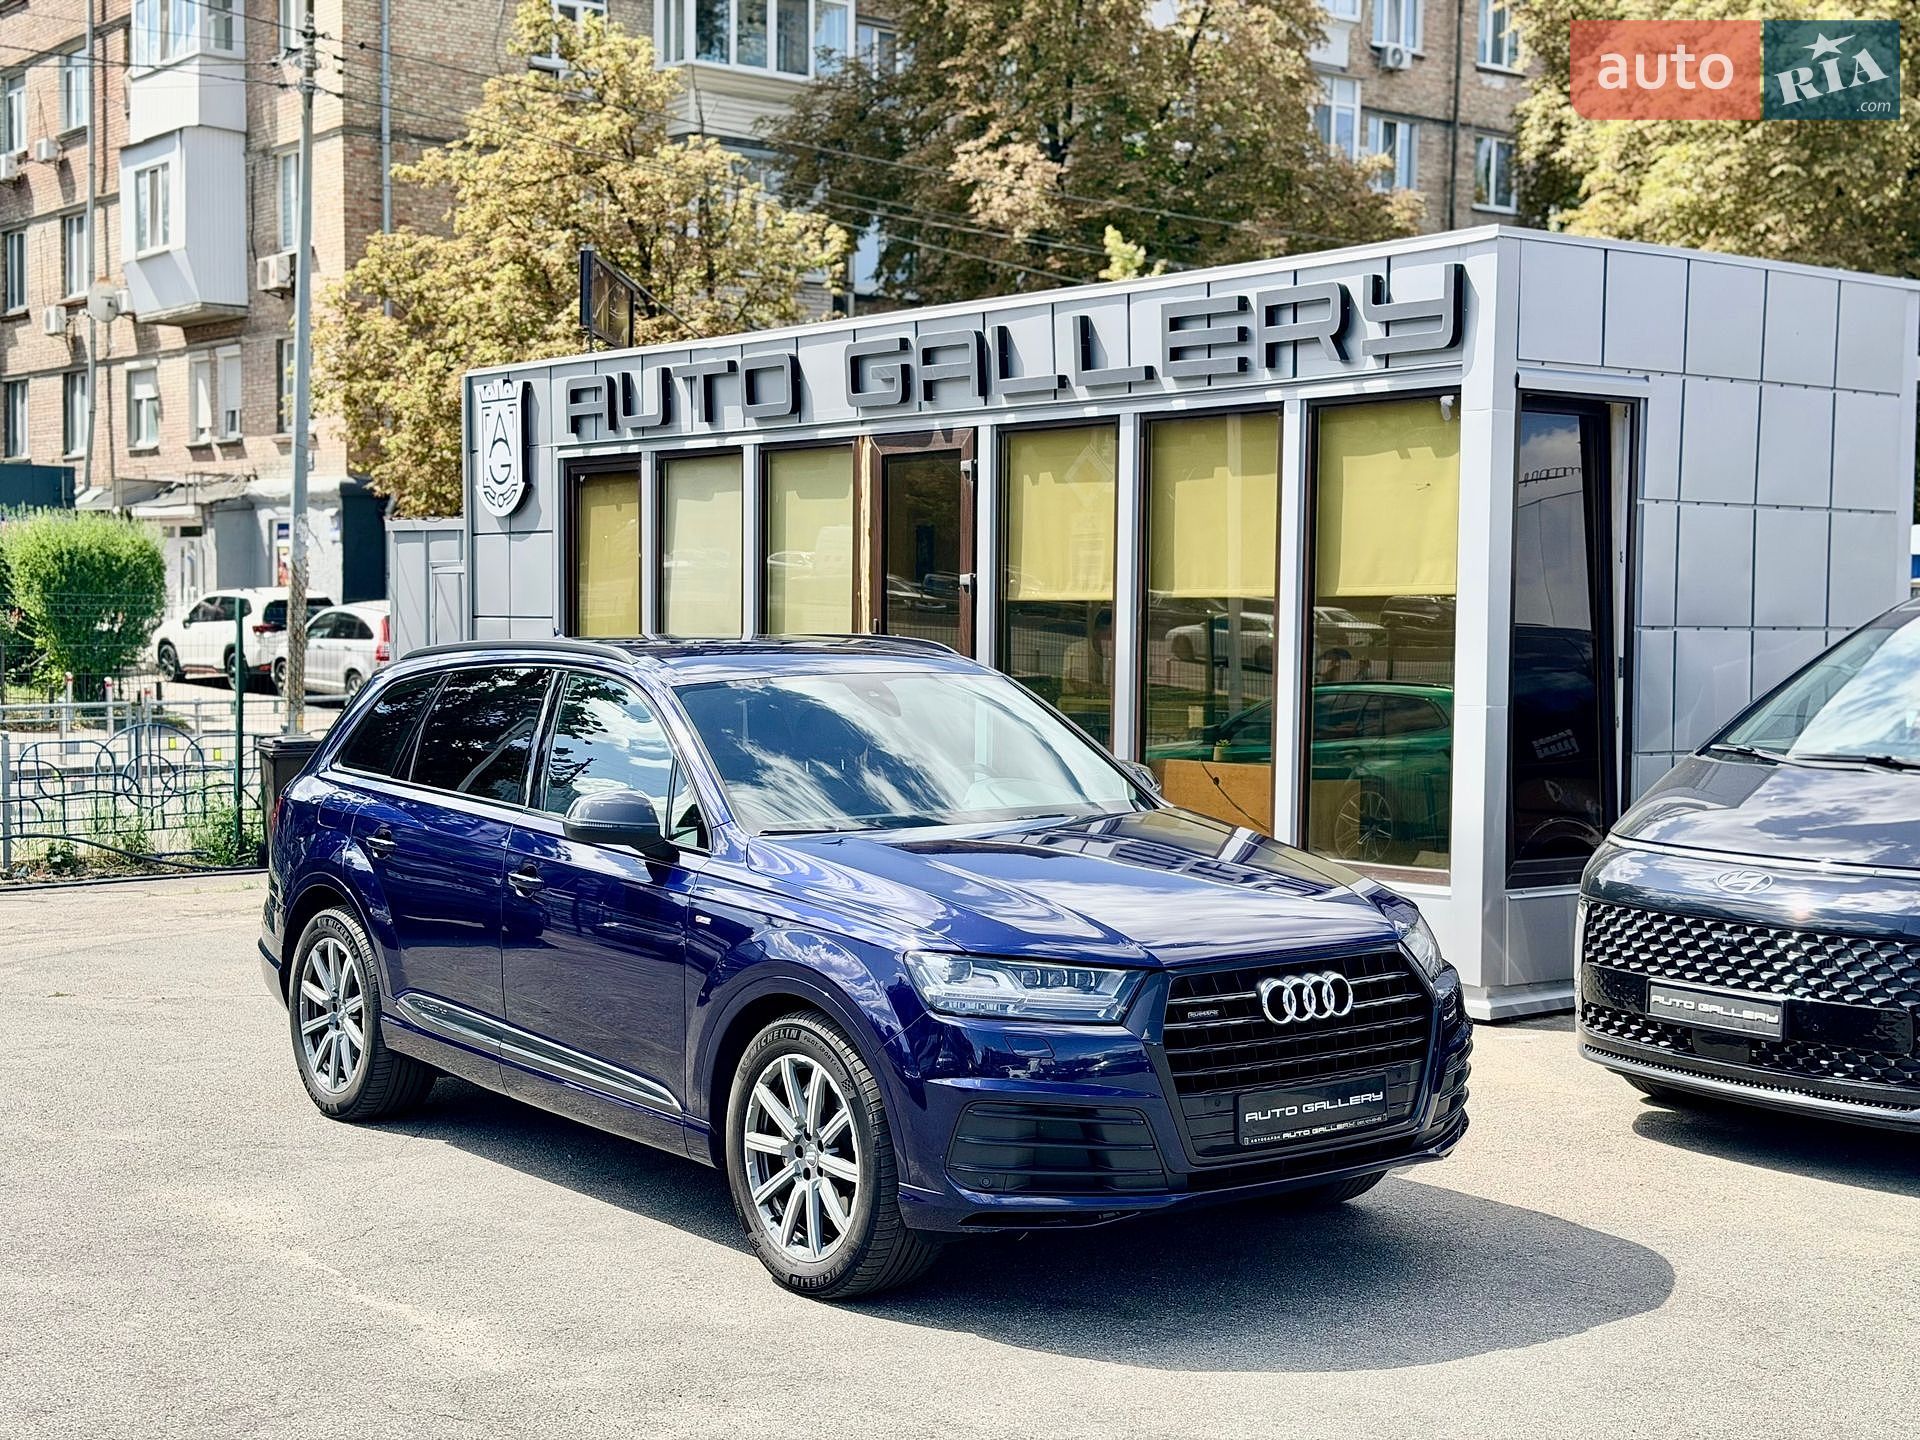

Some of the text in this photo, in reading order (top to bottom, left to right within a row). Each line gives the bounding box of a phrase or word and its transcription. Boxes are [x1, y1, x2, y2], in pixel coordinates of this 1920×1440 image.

[566, 263, 1465, 434] AUTO GALLERY
[1651, 994, 1779, 1024] AUTO GALLERY
[750, 1028, 799, 1057] MICHELIN
[1245, 1091, 1384, 1122] AUTO GALLERY
[1282, 1129, 1311, 1139] AUTO
[1312, 1121, 1355, 1135] GALLERY
